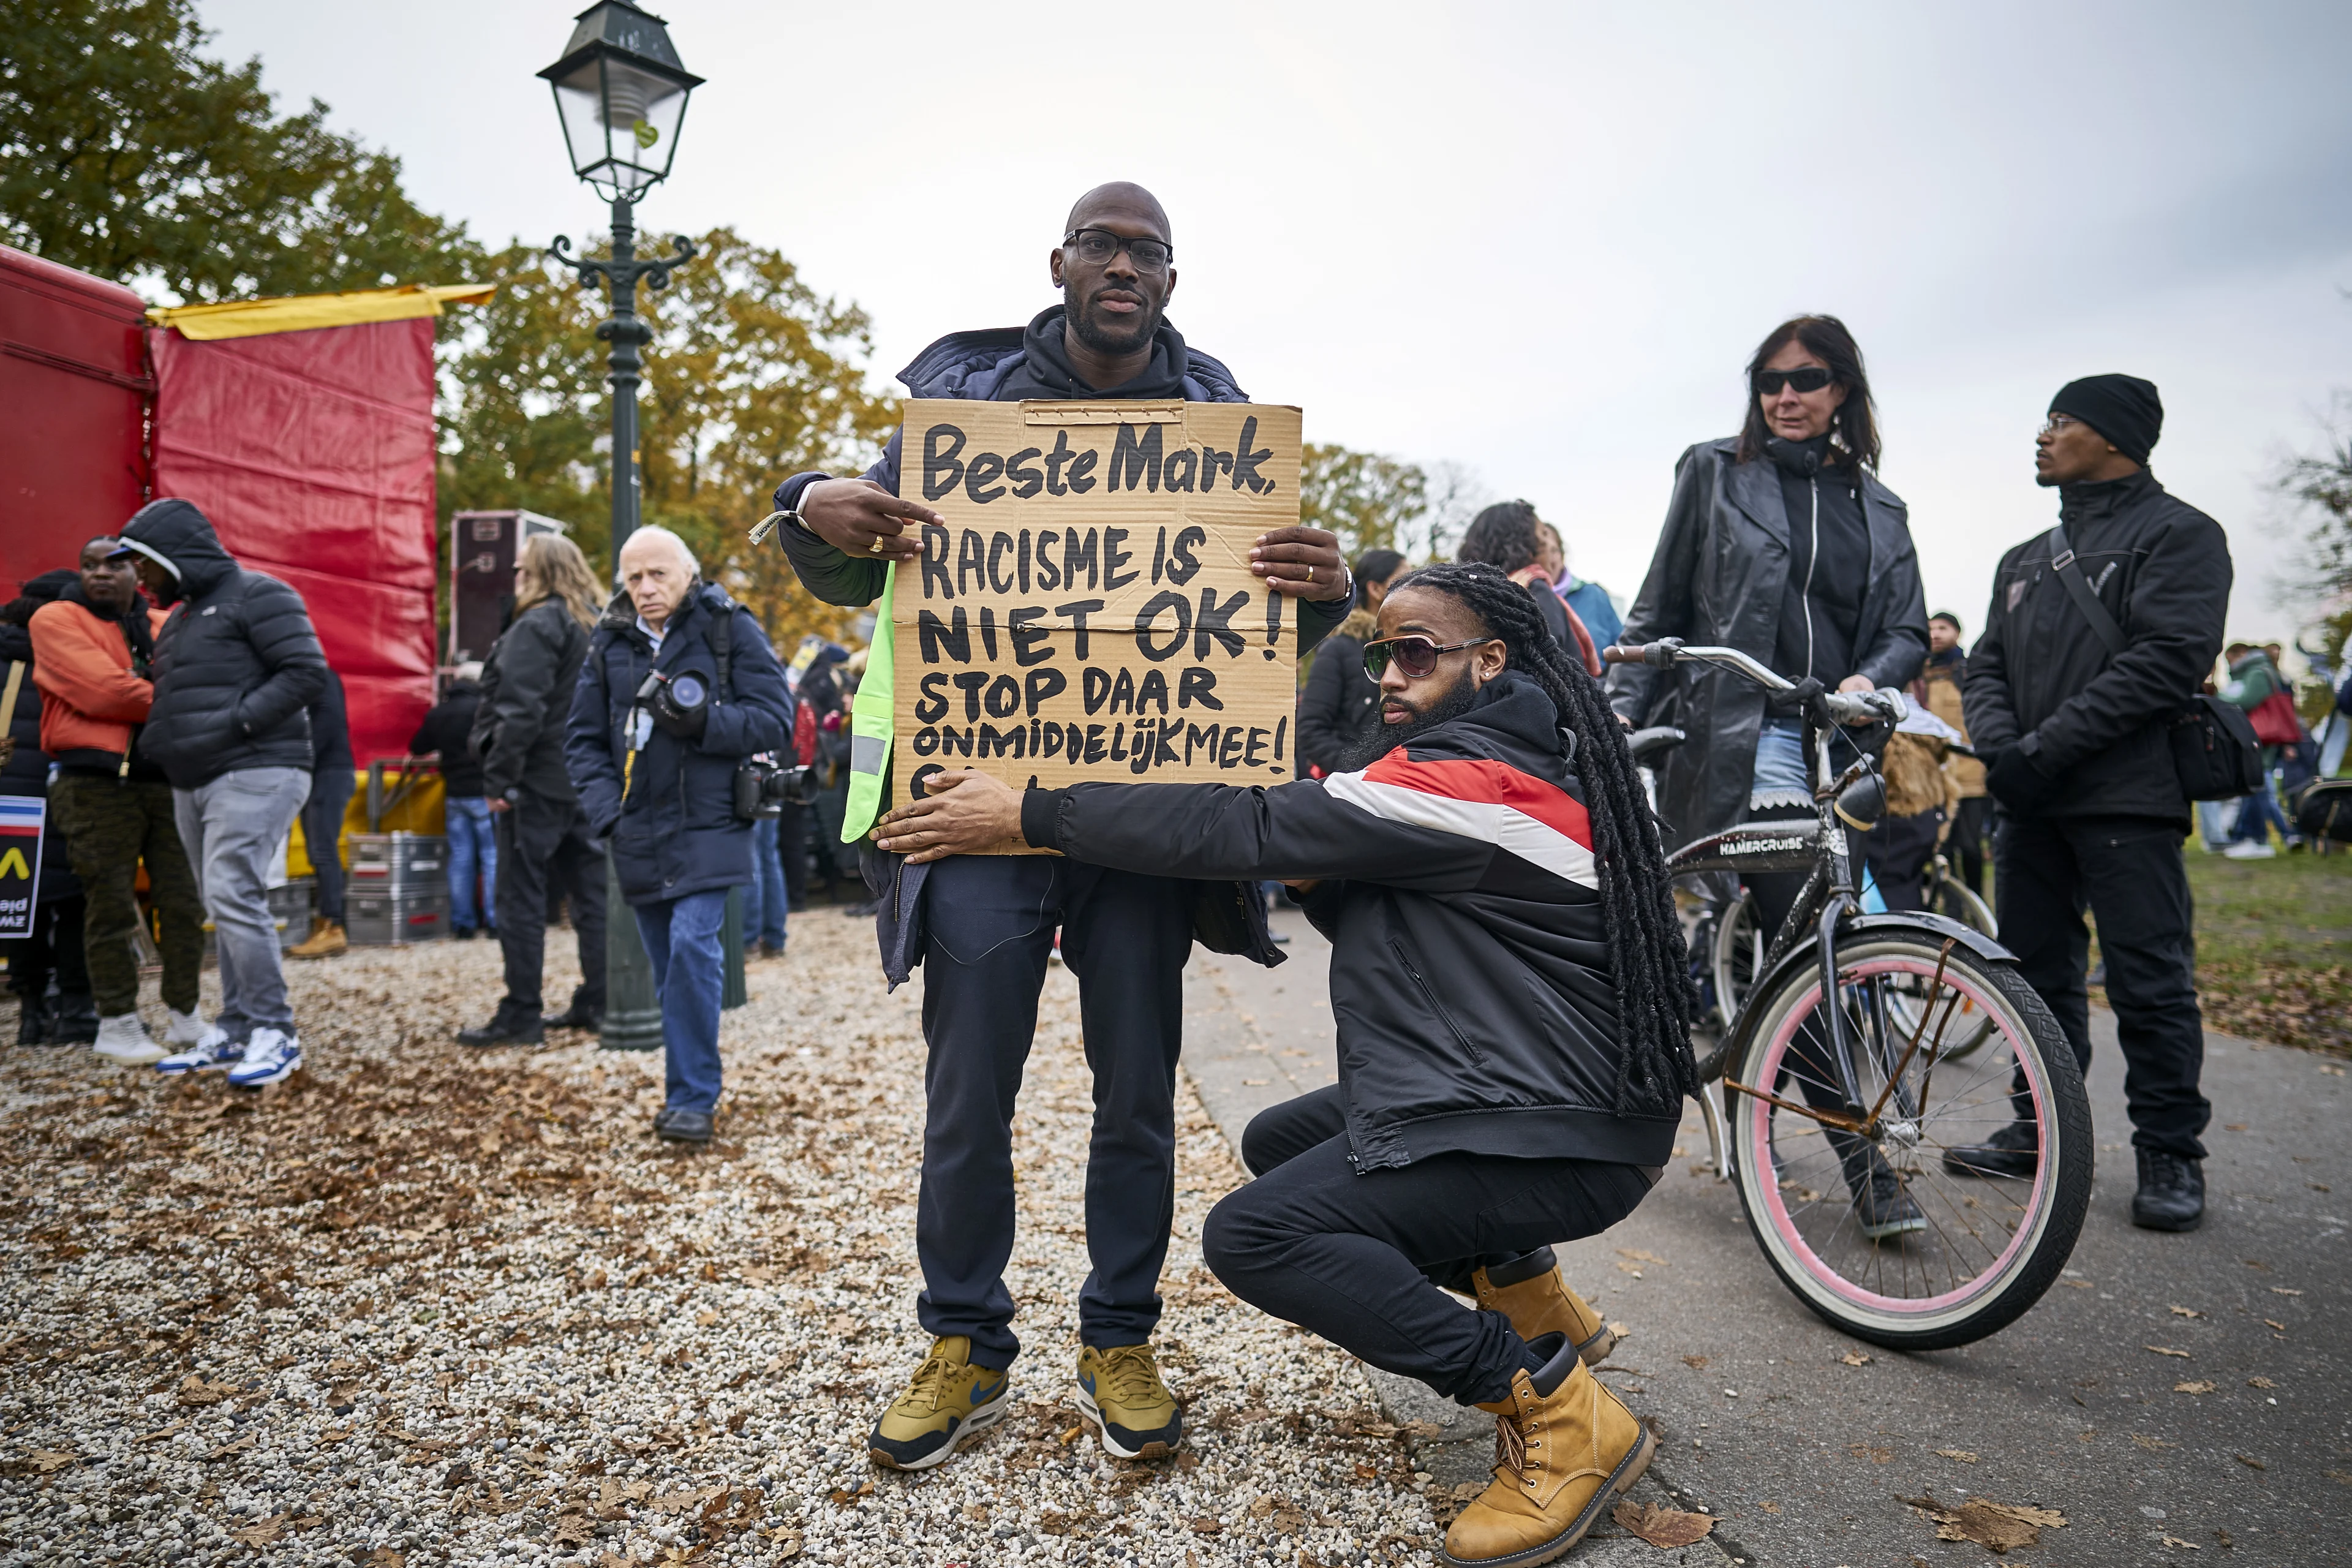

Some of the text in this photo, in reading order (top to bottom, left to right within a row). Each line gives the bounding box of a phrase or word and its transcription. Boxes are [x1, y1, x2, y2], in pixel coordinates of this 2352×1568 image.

[922, 416, 1276, 504] Beste Mark,
[921, 524, 1207, 600] RACISME IS
[919, 587, 1282, 666] NIET OK!
[915, 667, 1224, 725] STOP DAAR
[1719, 836, 1803, 856] HAMERCRUISE
